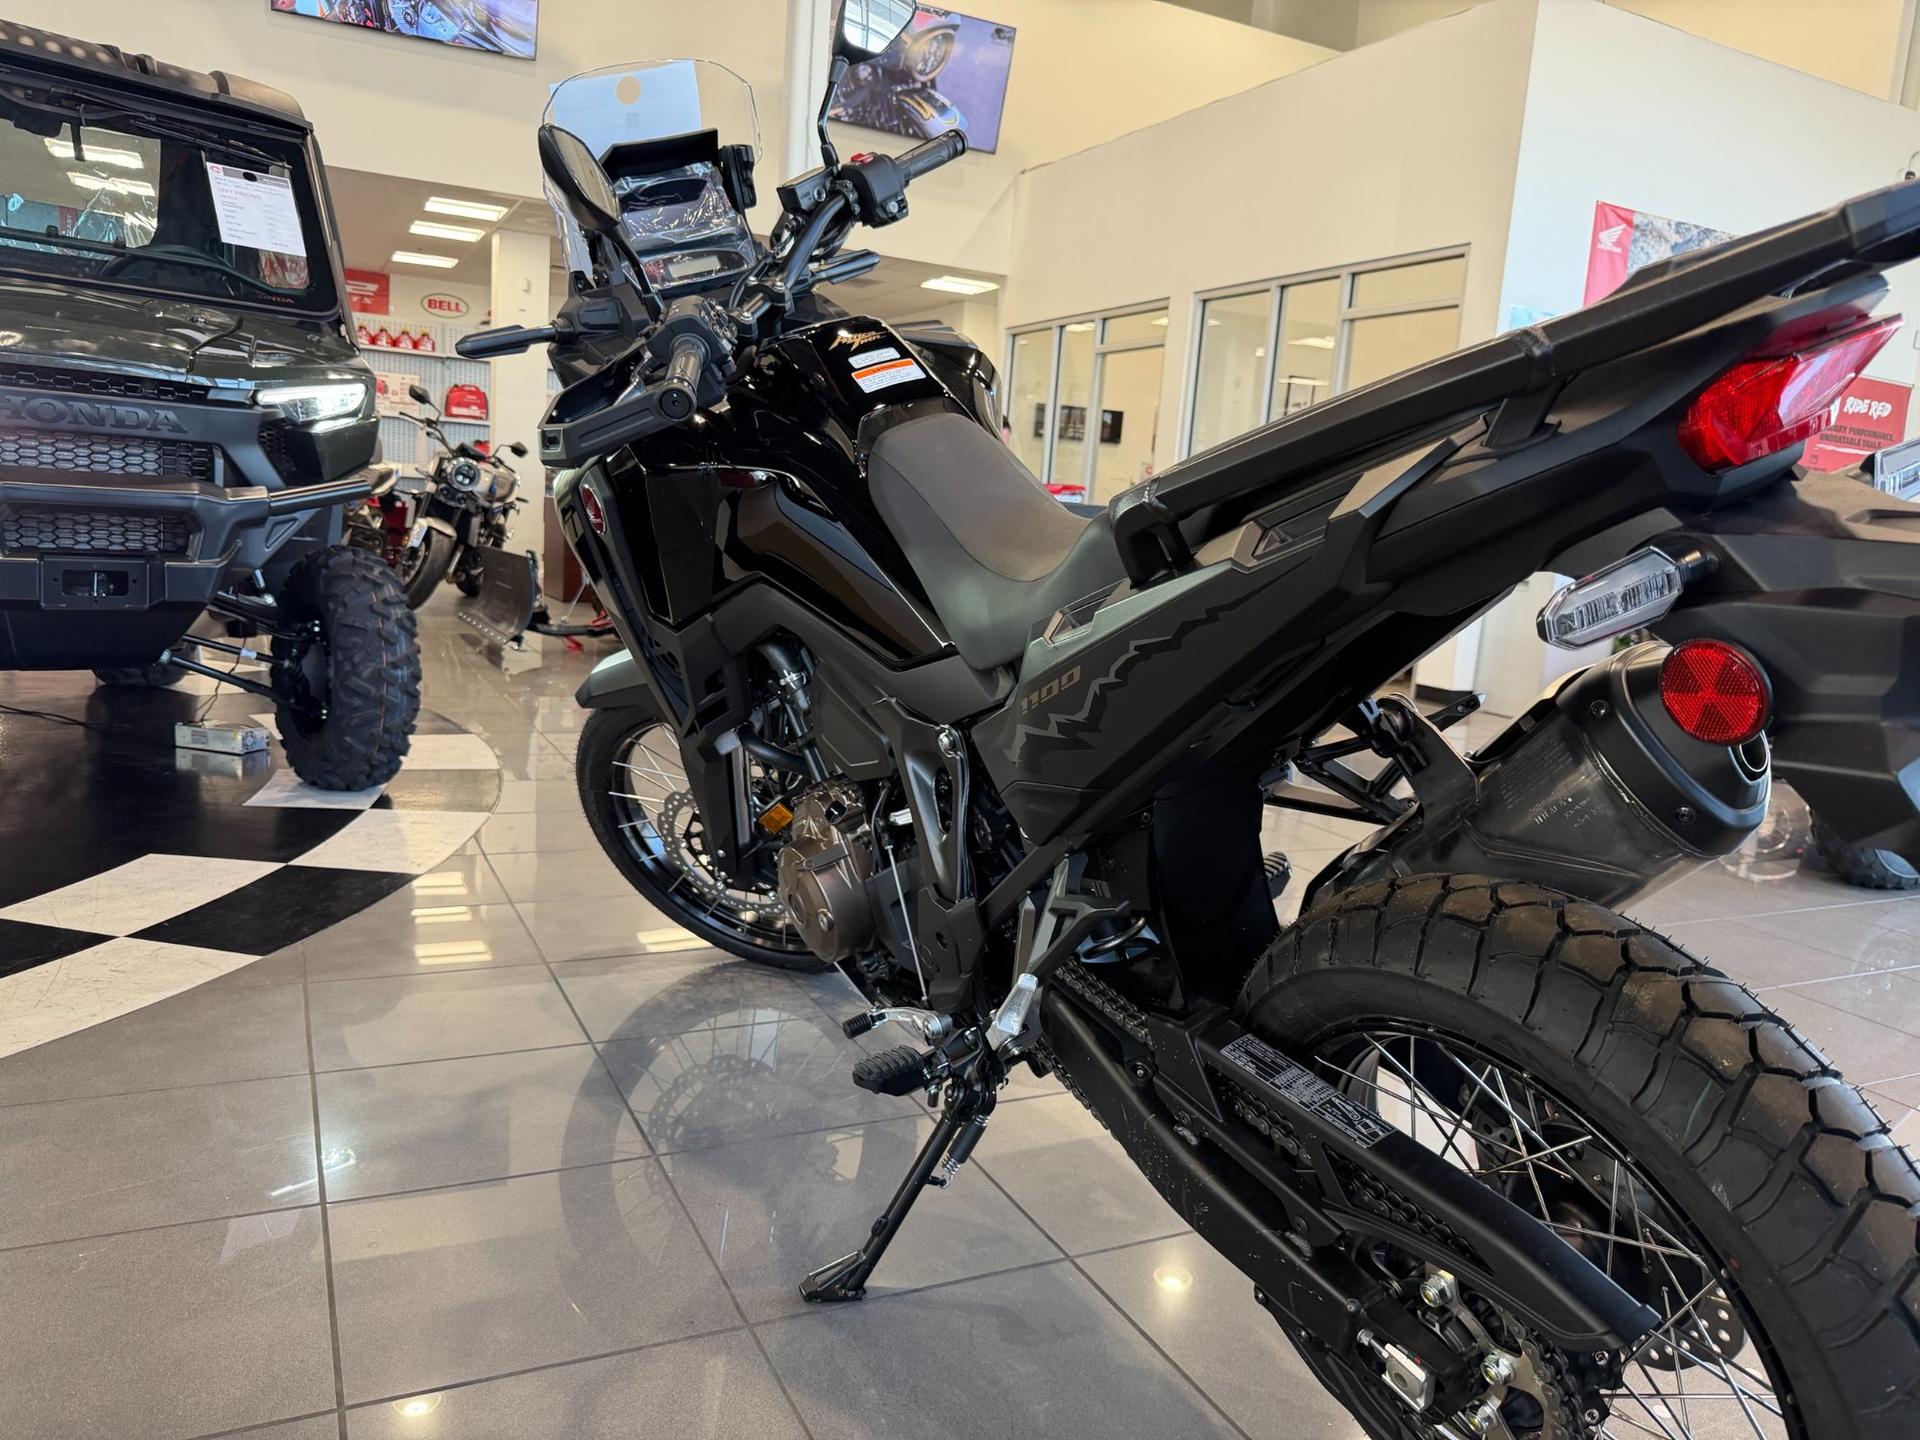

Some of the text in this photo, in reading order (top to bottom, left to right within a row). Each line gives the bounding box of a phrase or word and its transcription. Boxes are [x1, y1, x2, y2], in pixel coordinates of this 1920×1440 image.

[427, 298, 464, 313] BELL
[1843, 396, 1893, 420] RIDE RED
[1020, 665, 1081, 716] 1100
